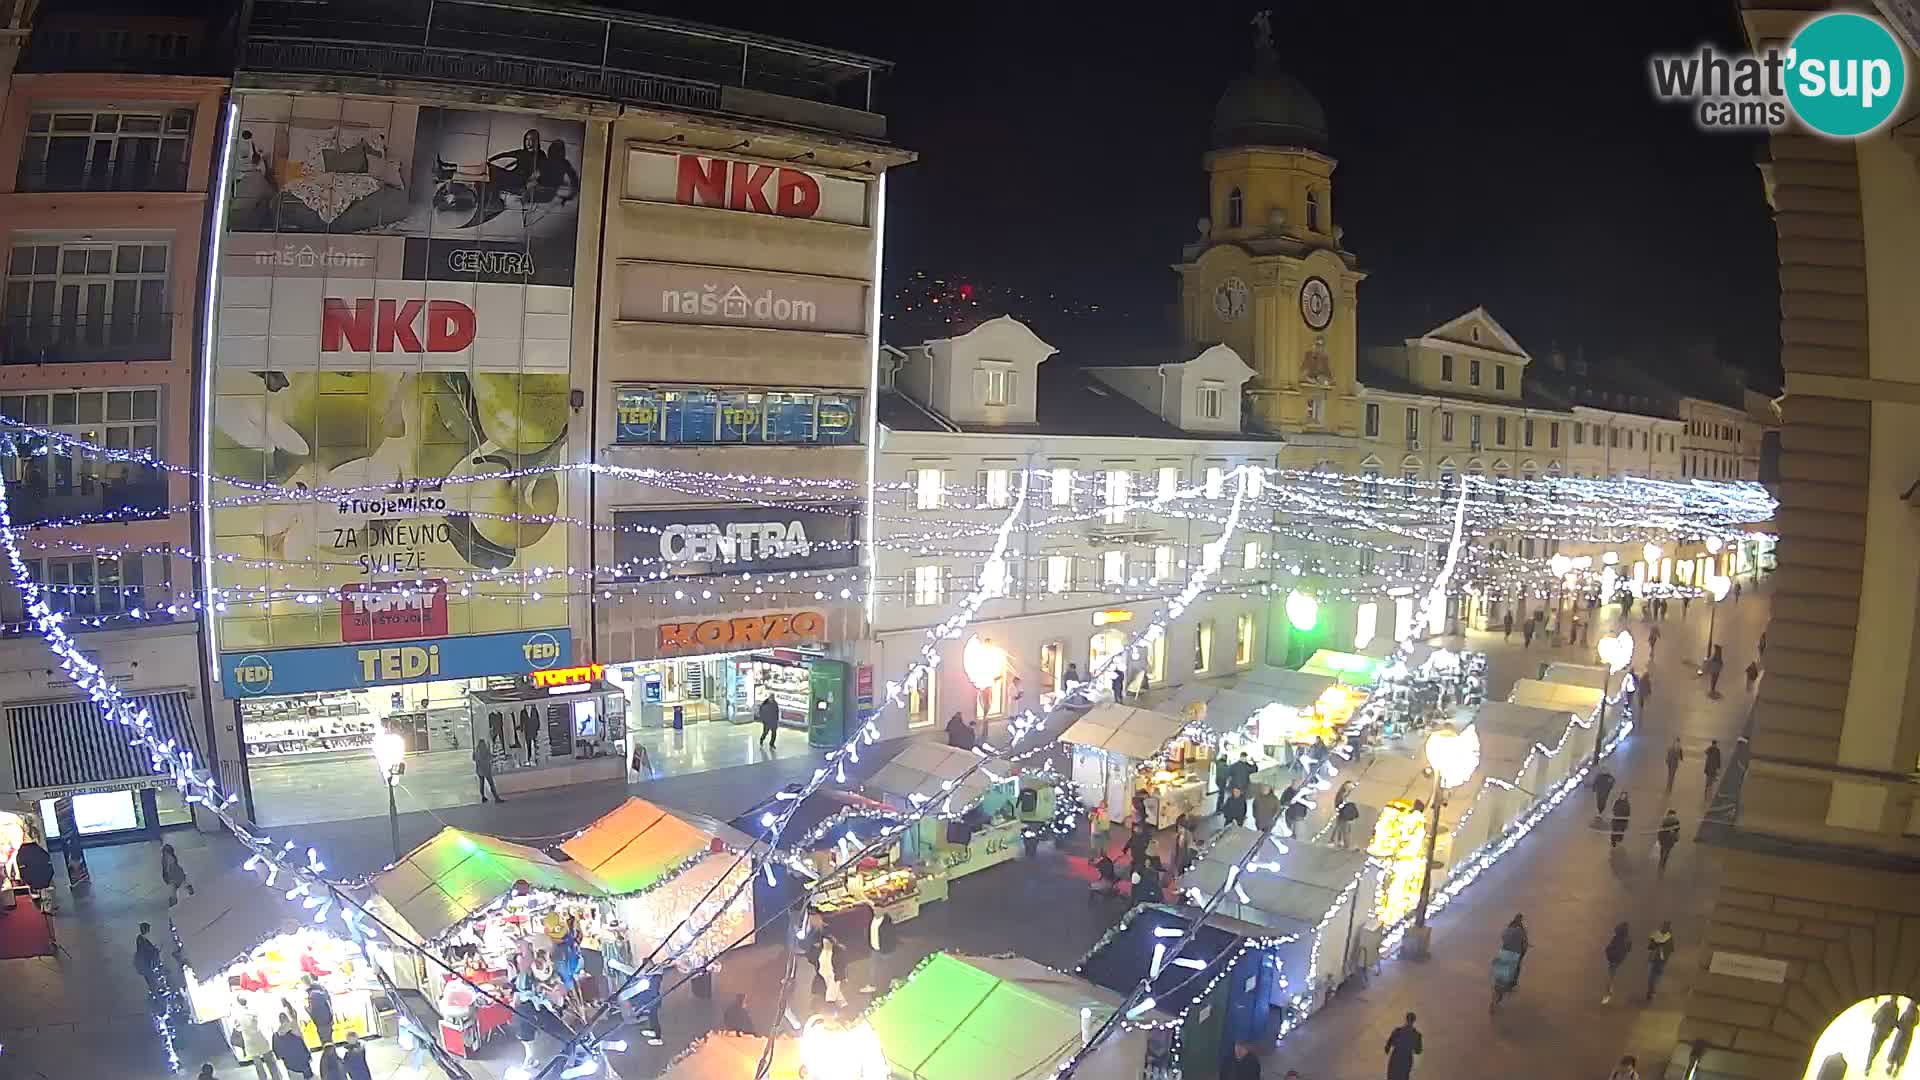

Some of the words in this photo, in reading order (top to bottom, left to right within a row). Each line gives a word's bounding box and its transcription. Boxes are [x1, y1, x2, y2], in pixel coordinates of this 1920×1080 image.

[675, 154, 821, 219] NKD
[448, 249, 536, 275] CENTRA
[661, 283, 718, 316] naš
[754, 289, 817, 322] dom
[321, 296, 477, 353] NKD
[338, 495, 447, 516] #TvojeMisto
[333, 526, 359, 549] ZA
[368, 522, 451, 547] DNEVNO
[659, 520, 810, 563] CENTRA
[358, 644, 441, 682] TEDi
[522, 643, 561, 661] TEDi
[234, 665, 273, 683] TEDi
[533, 663, 604, 688] TOMMY
